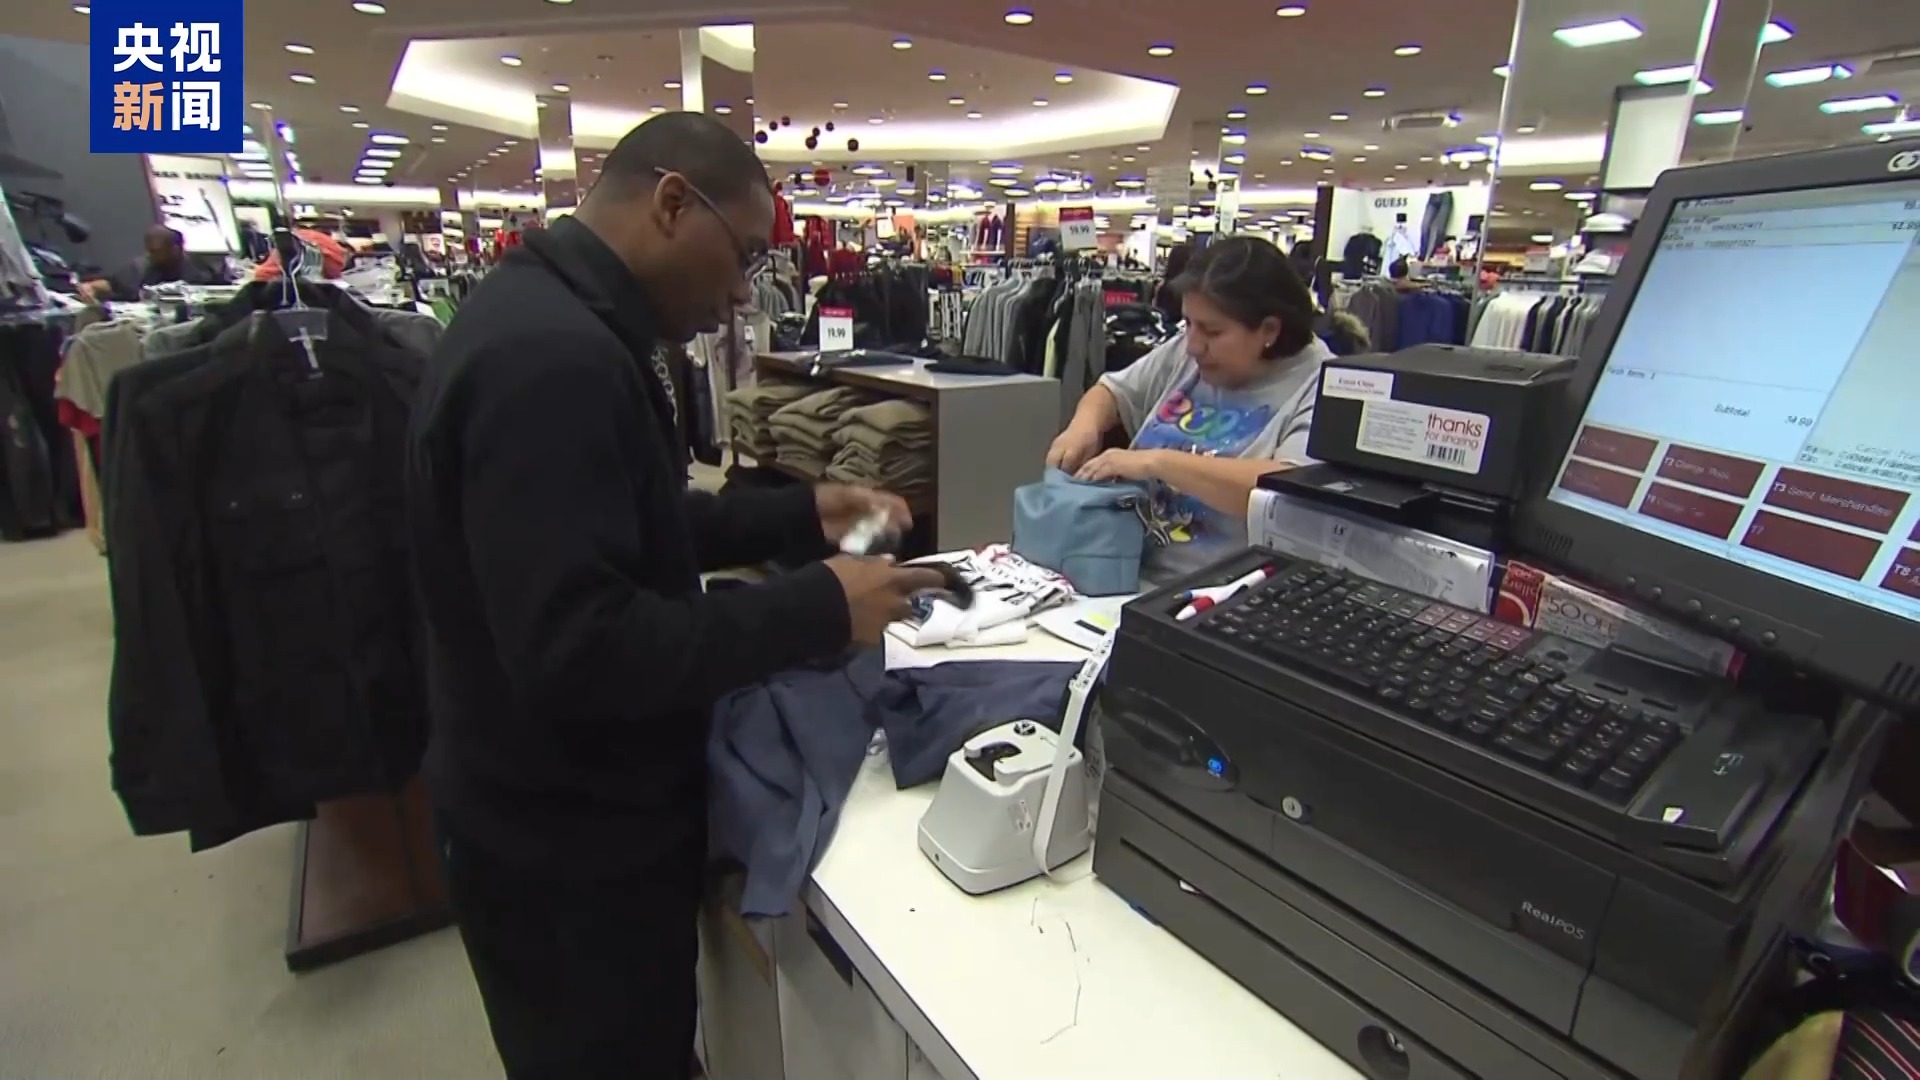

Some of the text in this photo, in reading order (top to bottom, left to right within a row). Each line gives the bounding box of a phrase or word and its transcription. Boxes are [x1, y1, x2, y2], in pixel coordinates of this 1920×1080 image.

[1374, 197, 1408, 208] GUESS
[1427, 411, 1483, 438] thanks
[1424, 431, 1480, 451] for sharing
[1521, 901, 1586, 940] RealPOS
